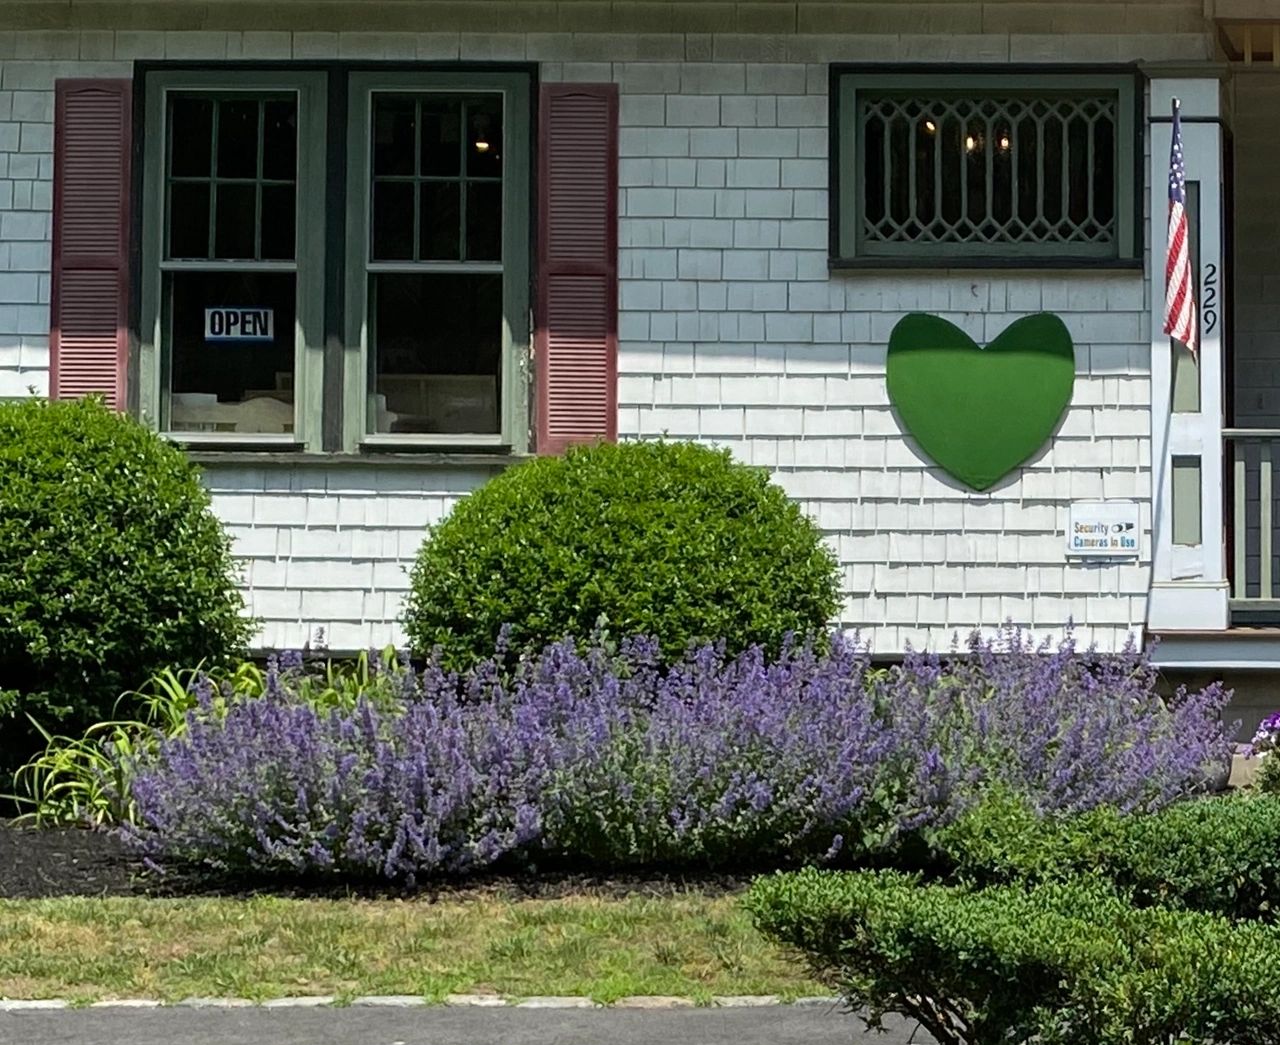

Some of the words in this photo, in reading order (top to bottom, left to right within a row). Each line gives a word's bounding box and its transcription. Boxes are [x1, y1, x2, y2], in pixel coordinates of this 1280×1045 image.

[1203, 263, 1217, 334] 229
[210, 310, 269, 336] OPEN
[1074, 522, 1109, 535] Security
[1074, 536, 1108, 547] Cameras
[1120, 536, 1135, 547] Use
